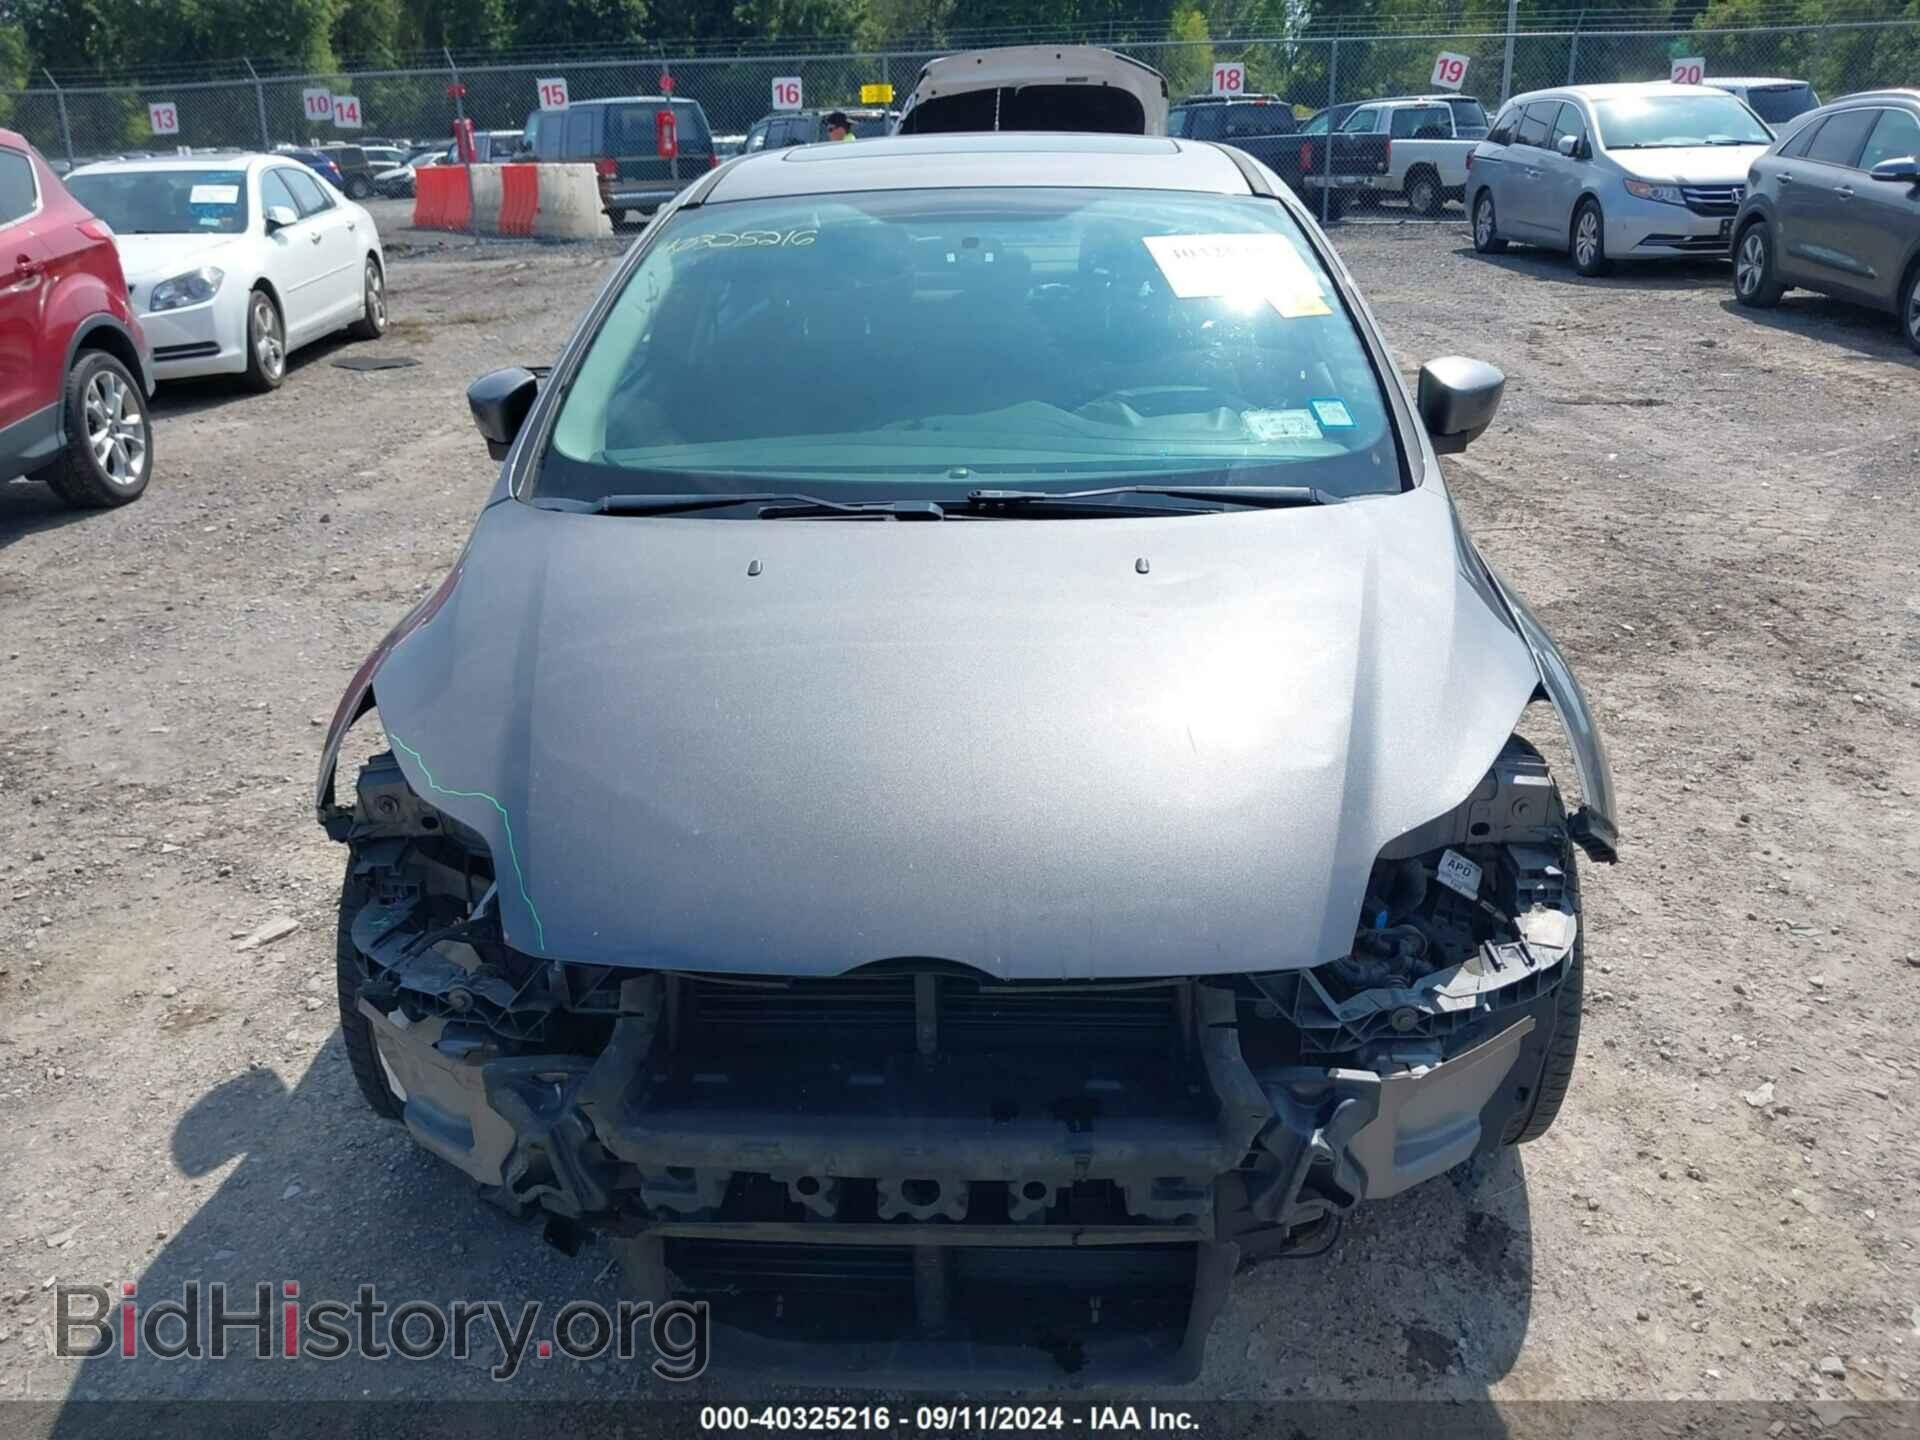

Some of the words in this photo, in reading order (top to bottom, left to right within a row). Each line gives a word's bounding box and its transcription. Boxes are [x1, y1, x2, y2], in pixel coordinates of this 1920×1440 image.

[1215, 69, 1241, 92] 18
[1438, 58, 1464, 83] 19
[1673, 65, 1701, 85] 20
[541, 84, 565, 106] 15
[774, 83, 799, 104] 16
[306, 96, 330, 114] 10
[336, 103, 359, 123] 14
[153, 109, 176, 129] 13
